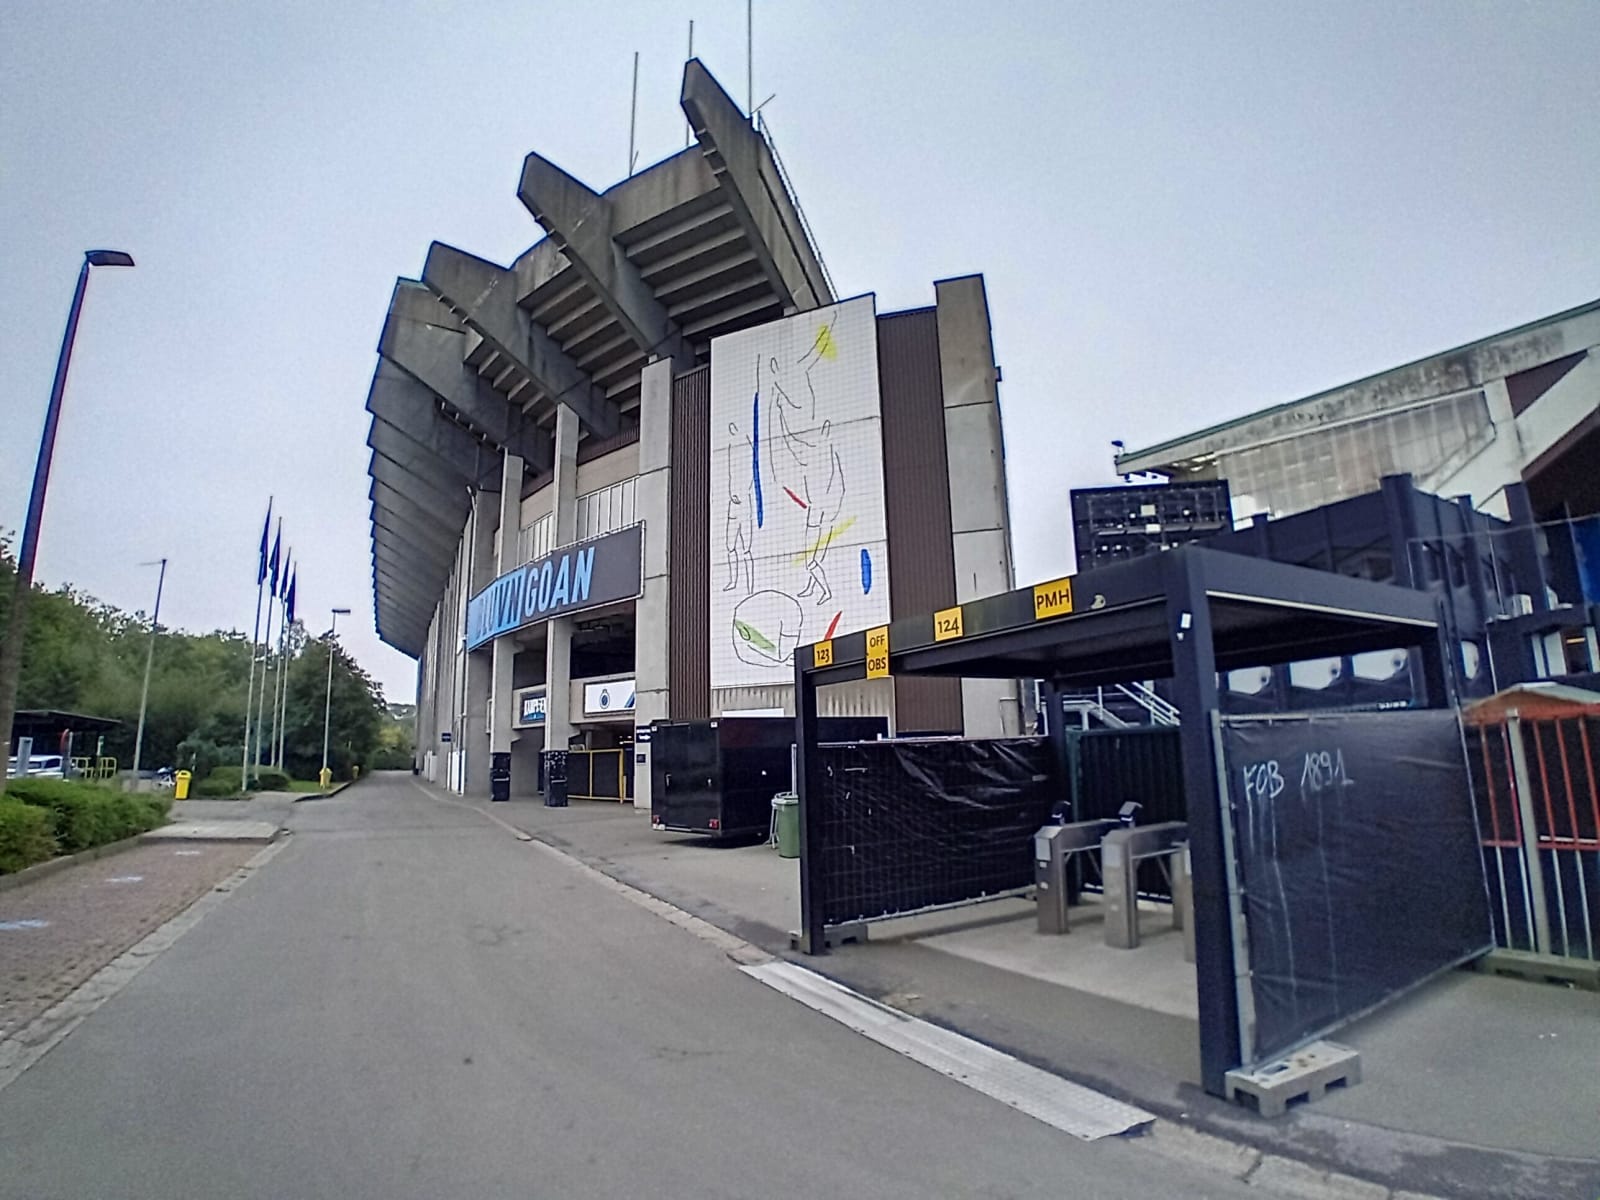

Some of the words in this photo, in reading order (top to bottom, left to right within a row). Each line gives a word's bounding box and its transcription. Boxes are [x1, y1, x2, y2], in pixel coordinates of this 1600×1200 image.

[525, 546, 595, 617] GOAN
[1036, 588, 1070, 610] PMH
[937, 617, 960, 634] 124
[869, 634, 886, 648] OFF
[816, 649, 830, 662] 123
[868, 657, 887, 672] OBS
[1301, 748, 1354, 791] 1891
